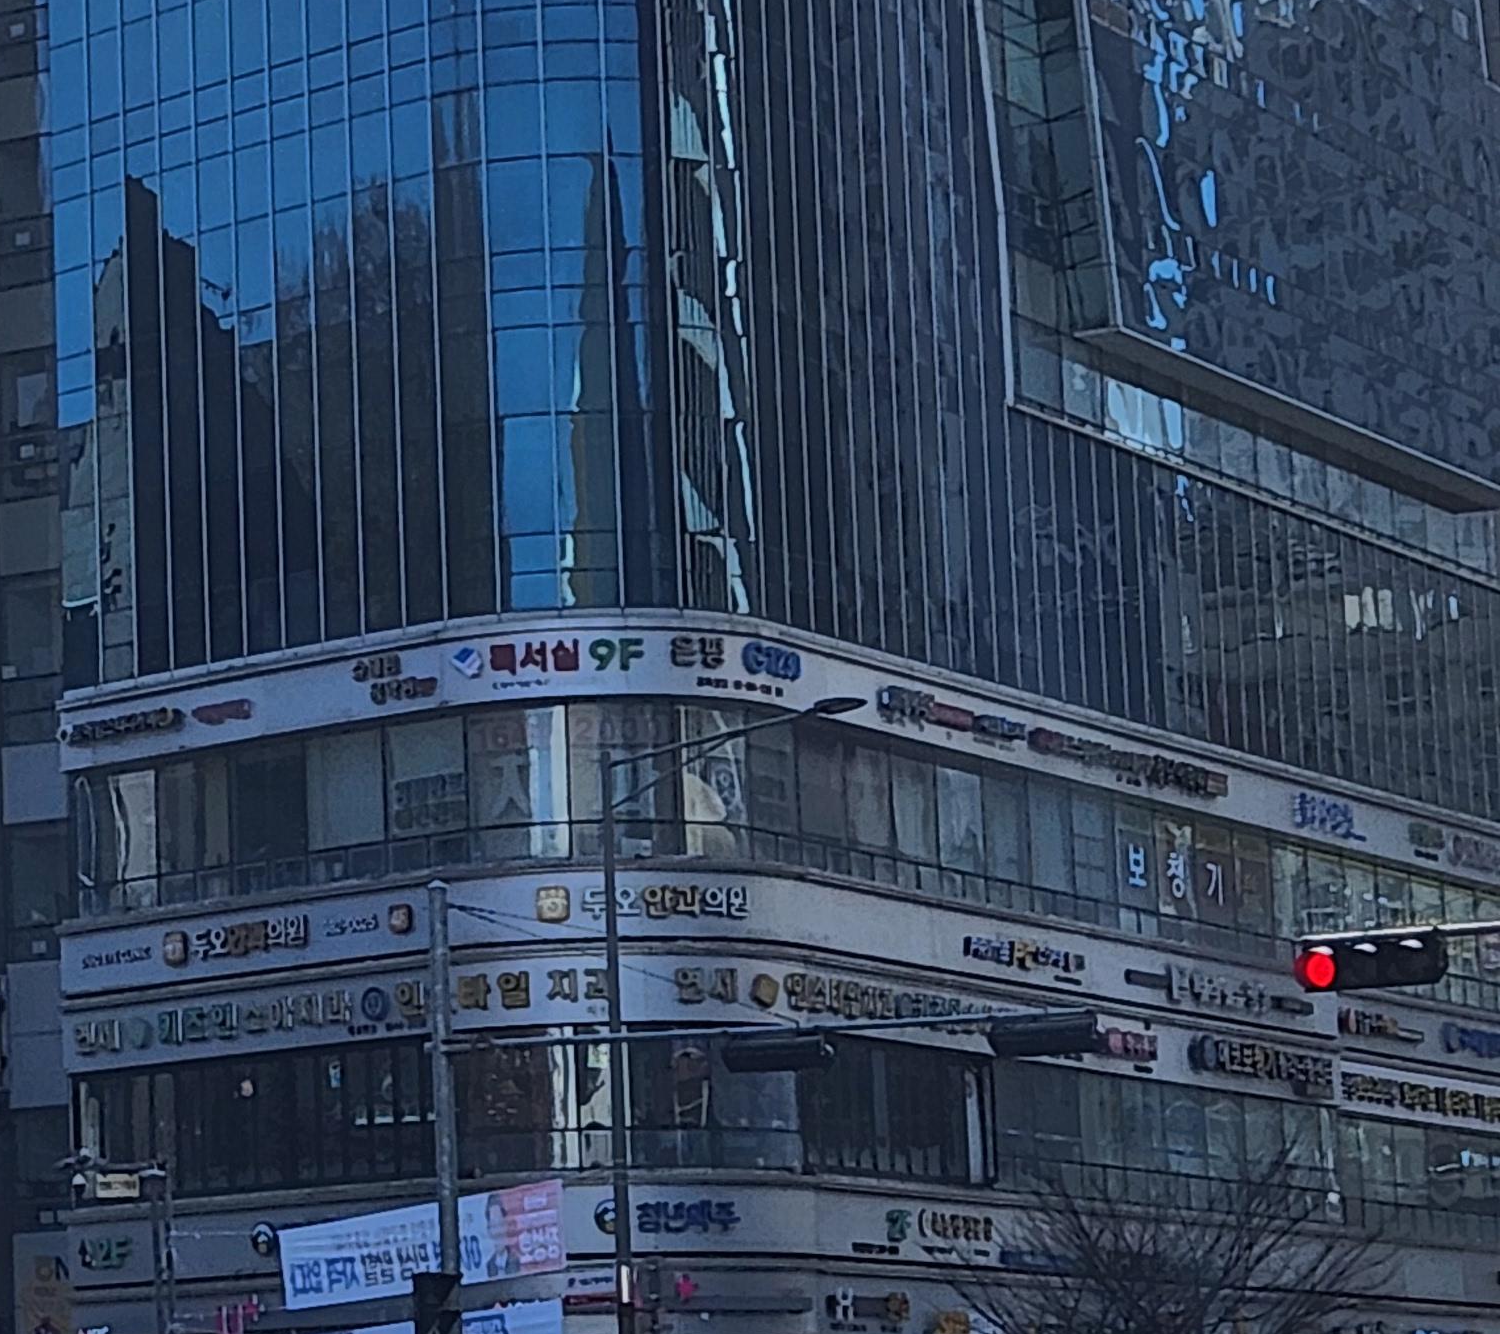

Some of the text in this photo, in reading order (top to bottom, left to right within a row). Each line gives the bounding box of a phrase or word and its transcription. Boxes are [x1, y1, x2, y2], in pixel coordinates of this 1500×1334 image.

[489, 637, 645, 675] 독서실 9F
[582, 885, 749, 920] 두오안과의원
